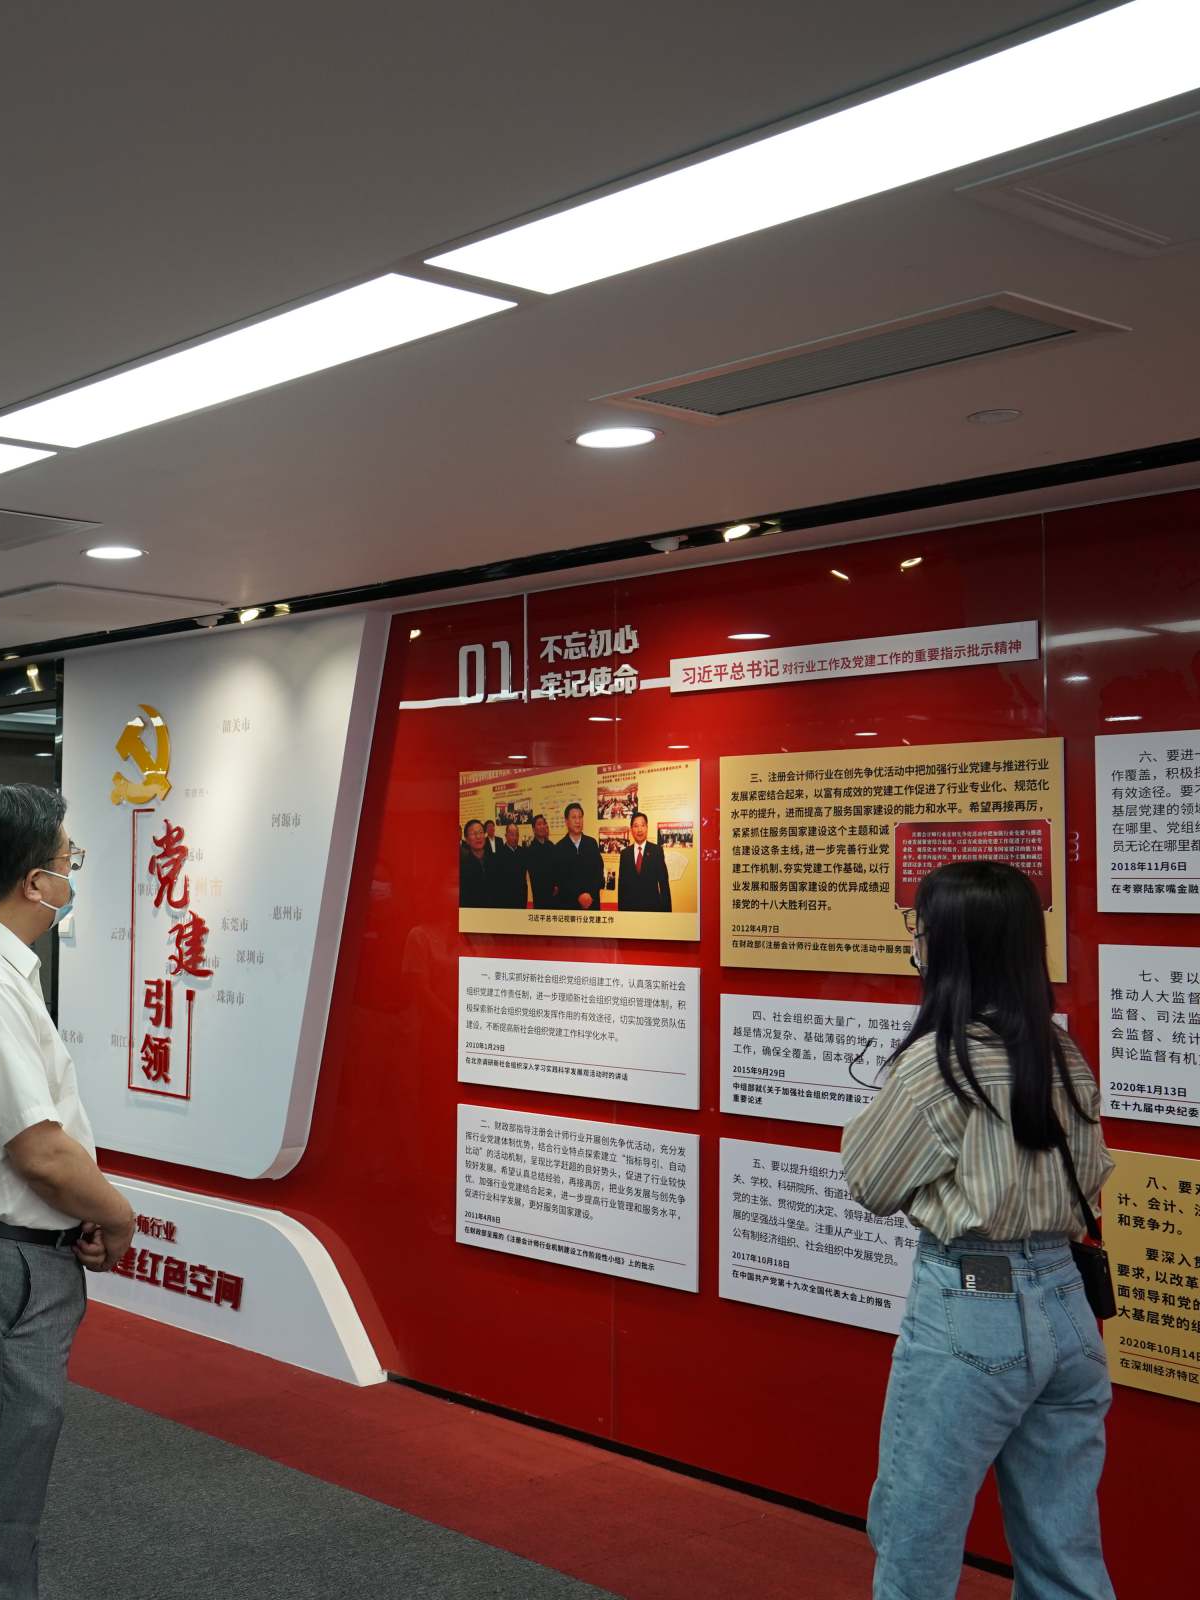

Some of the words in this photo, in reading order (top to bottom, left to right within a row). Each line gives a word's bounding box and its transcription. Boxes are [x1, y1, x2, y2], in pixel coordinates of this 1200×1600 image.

[540, 624, 640, 663] 不忘初心
[458, 640, 516, 703] 01
[540, 663, 639, 701] 牢记使命
[749, 758, 1050, 784] 三、注册会计师行业在创先争优活动中把加强行业党建与推进行业
[731, 779, 1050, 802] 发展紧密结合起来，以富有成效的党建工作促进了行业专业化、规范化
[731, 800, 1045, 819] 水平的提升，进而提高了服务国家建设的能力和水平。希望再接再厉，
[271, 812, 301, 828] 河源市
[732, 825, 890, 839] 紧紧抓住服务国家建设这个主题和诚
[1110, 861, 1188, 872] 2018年11月6日
[732, 879, 890, 894] 业发展和服务国家建设的优异成绩迎
[1111, 884, 1199, 895] 在考察陆家嘴金融
[272, 905, 302, 921] 惠州市
[732, 898, 833, 912] 接党的十八大胜利召开。
[221, 917, 249, 932] 东莞市
[731, 924, 780, 934] 2012年4月7日
[732, 939, 913, 955] 在财政部《注册会计师行业在创先争优活动中服务国
[236, 949, 265, 965] 深圳市
[216, 990, 245, 1005] 珠海市
[1111, 988, 1200, 1005] 推动人大监督
[1111, 1008, 1200, 1025] 监督、司法监
[1111, 1027, 1200, 1046] 会监督、统计
[1111, 1046, 1200, 1066] 舆论监督有机
[732, 1065, 785, 1078] 2015年9月29日
[732, 1082, 874, 1104] 中组部就《关于加强社会组织党的建设工
[1110, 1081, 1187, 1098] 2020年1月13日
[732, 1093, 763, 1105] 重要论述
[1110, 1099, 1199, 1118] 在十九届中央纪委
[732, 1192, 920, 1231] 党的主张、贯彻党的决定、领导基层治理、
[134, 1214, 177, 1242] 师行业
[1117, 1213, 1183, 1236] 和竞争力。
[732, 1228, 899, 1267] 公有制经济组织、社会组织中发展党员。
[732, 1251, 790, 1269] 2017年10月18日
[732, 1269, 892, 1309] 在中国共产党第十九次全国代表大会上的报告
[1119, 1357, 1200, 1384] 在深圳经济特区
